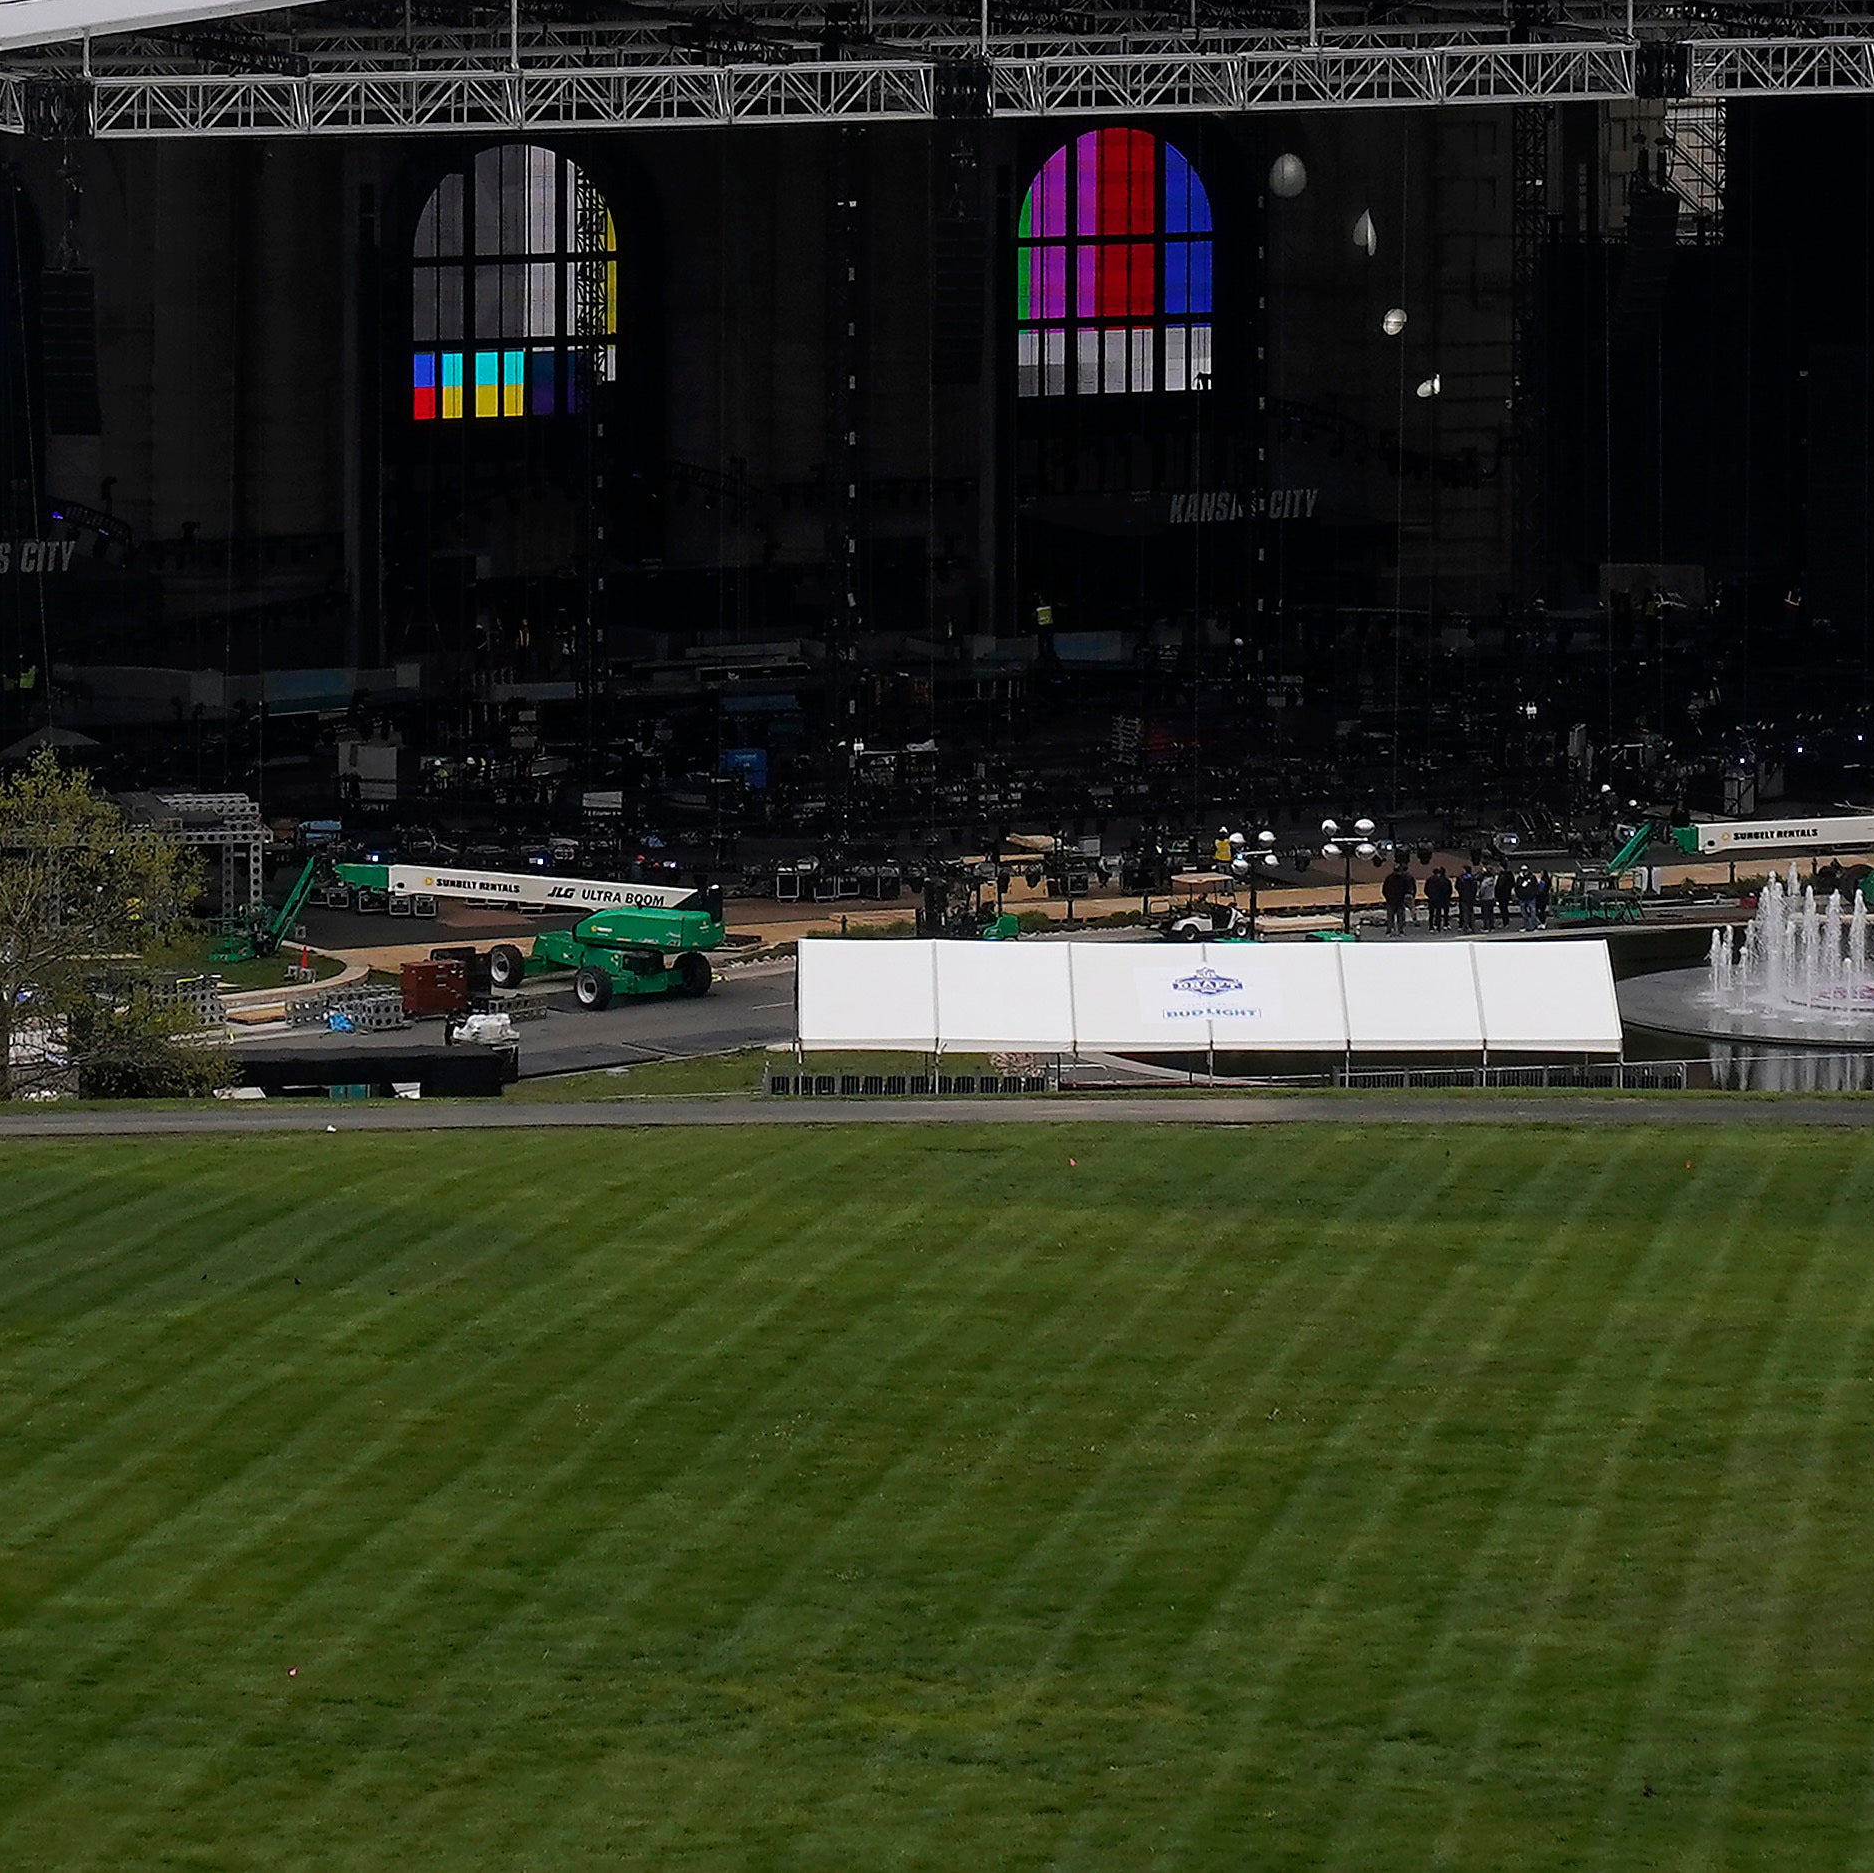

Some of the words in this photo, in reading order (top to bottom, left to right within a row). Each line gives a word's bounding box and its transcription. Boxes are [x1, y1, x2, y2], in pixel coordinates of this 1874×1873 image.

[1268, 488, 1319, 520] CITY
[20, 540, 77, 574] CITY
[1733, 830, 1776, 841] SUNBELT
[1776, 828, 1819, 839] RENTALS
[436, 877, 477, 890] SUNBELT
[478, 880, 521, 893] RENTALS
[547, 886, 576, 899] JLG
[581, 889, 622, 903] ULTRA
[624, 892, 665, 907] BOOM
[1166, 1009, 1204, 1018] BUD
[1206, 1007, 1256, 1017] LIGHT
